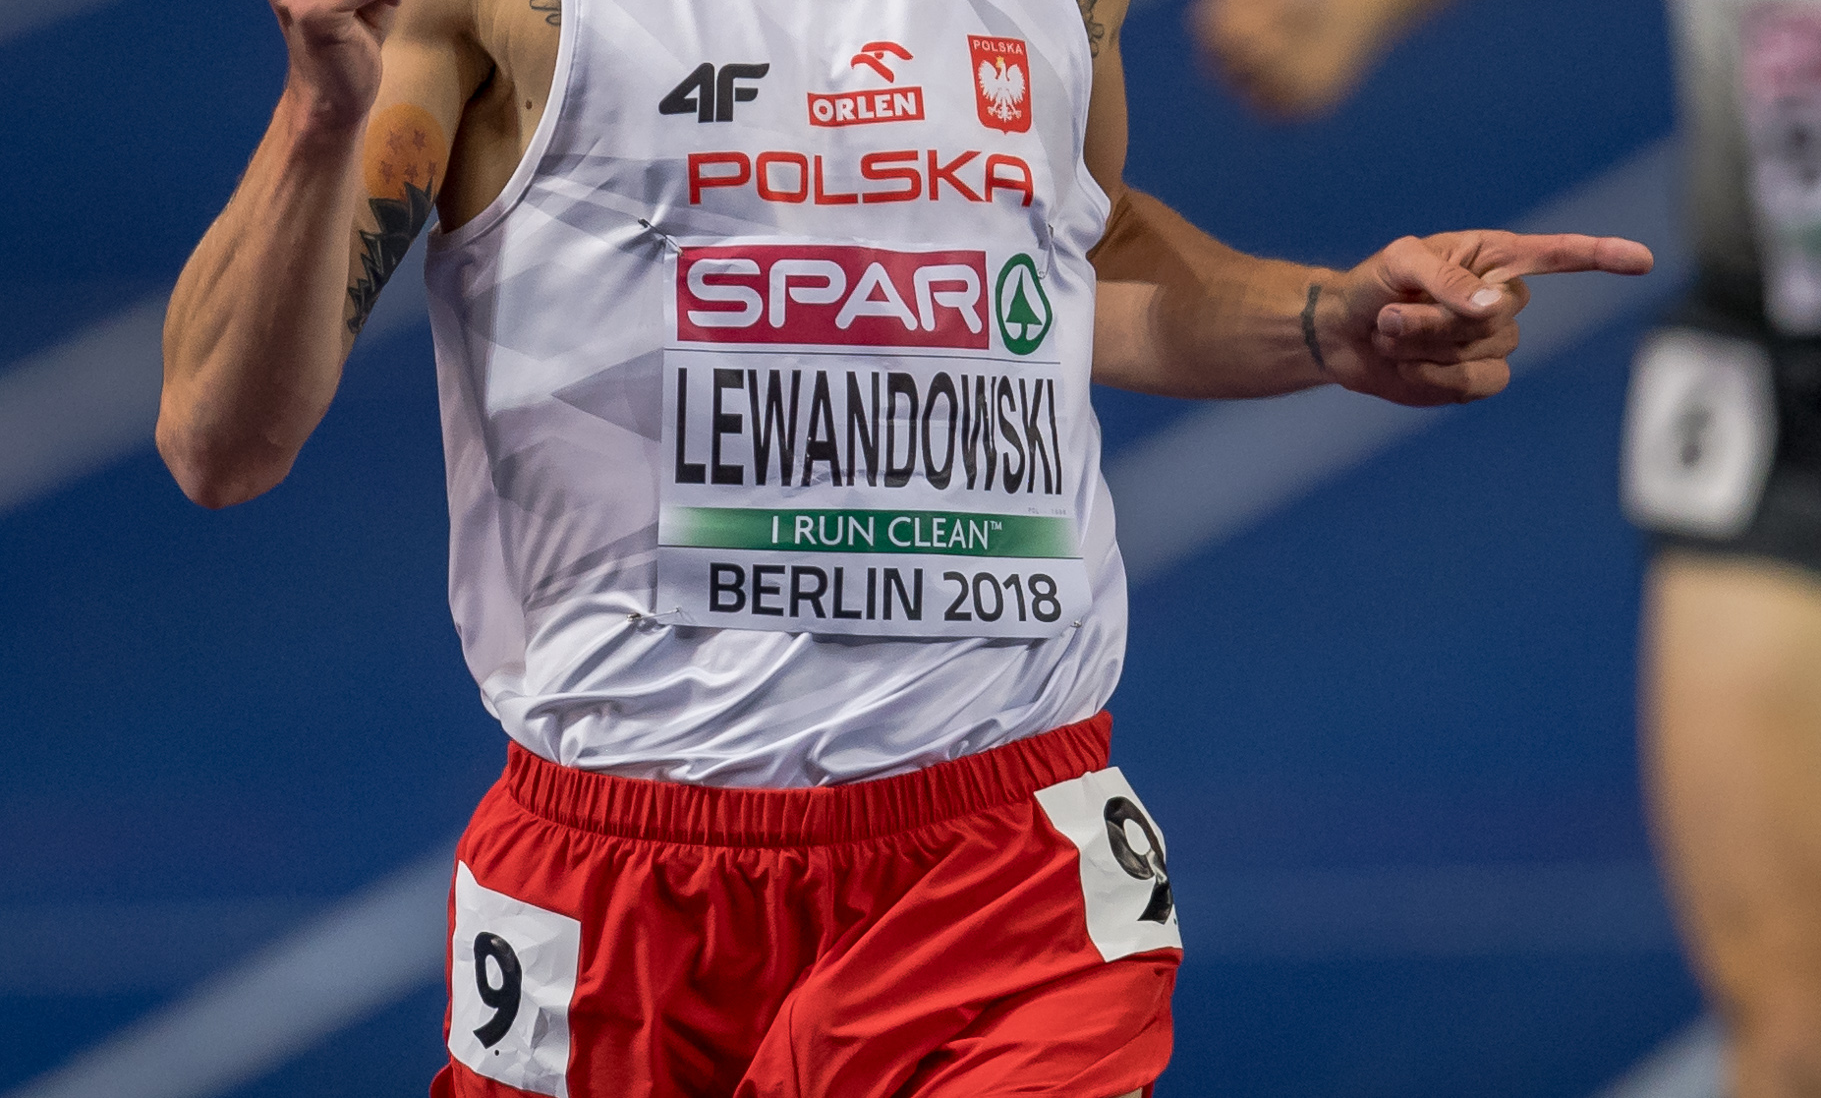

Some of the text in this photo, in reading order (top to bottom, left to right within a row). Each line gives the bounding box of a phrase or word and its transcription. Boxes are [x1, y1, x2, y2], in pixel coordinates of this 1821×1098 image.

[973, 40, 1023, 55] POLSKA
[659, 62, 770, 123] 4F
[813, 92, 917, 122] ORLEN
[688, 149, 1034, 207] POLSKA
[687, 259, 983, 333] SPAR
[675, 367, 1063, 495] LEWANDOWSKI
[771, 515, 779, 543] I
[794, 515, 874, 546] RUN
[709, 562, 1062, 623] BERLIN 2018
